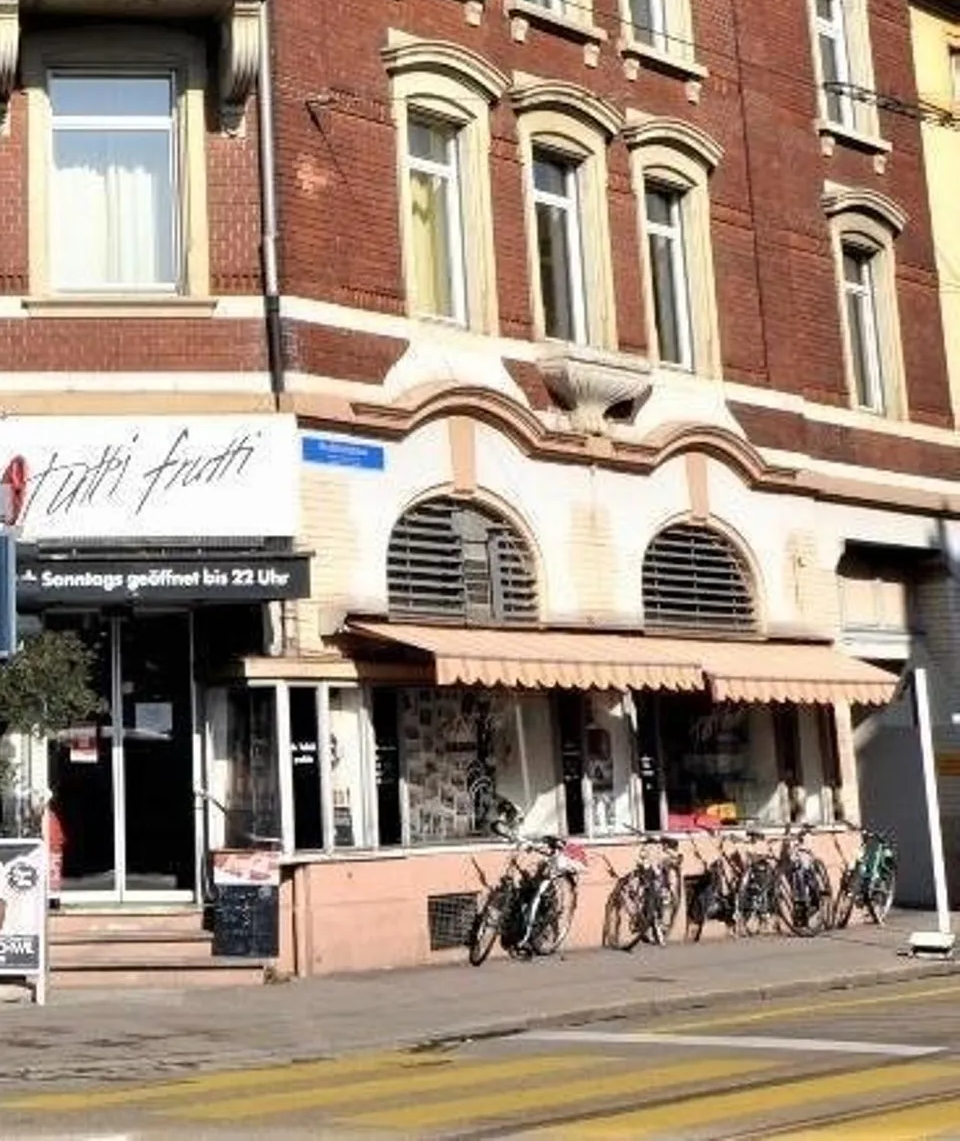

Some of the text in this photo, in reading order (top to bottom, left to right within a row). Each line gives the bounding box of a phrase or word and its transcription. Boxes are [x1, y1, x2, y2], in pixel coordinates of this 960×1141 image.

[41, 567, 290, 591] Sonntags geöffnet bis 22 Uhr
